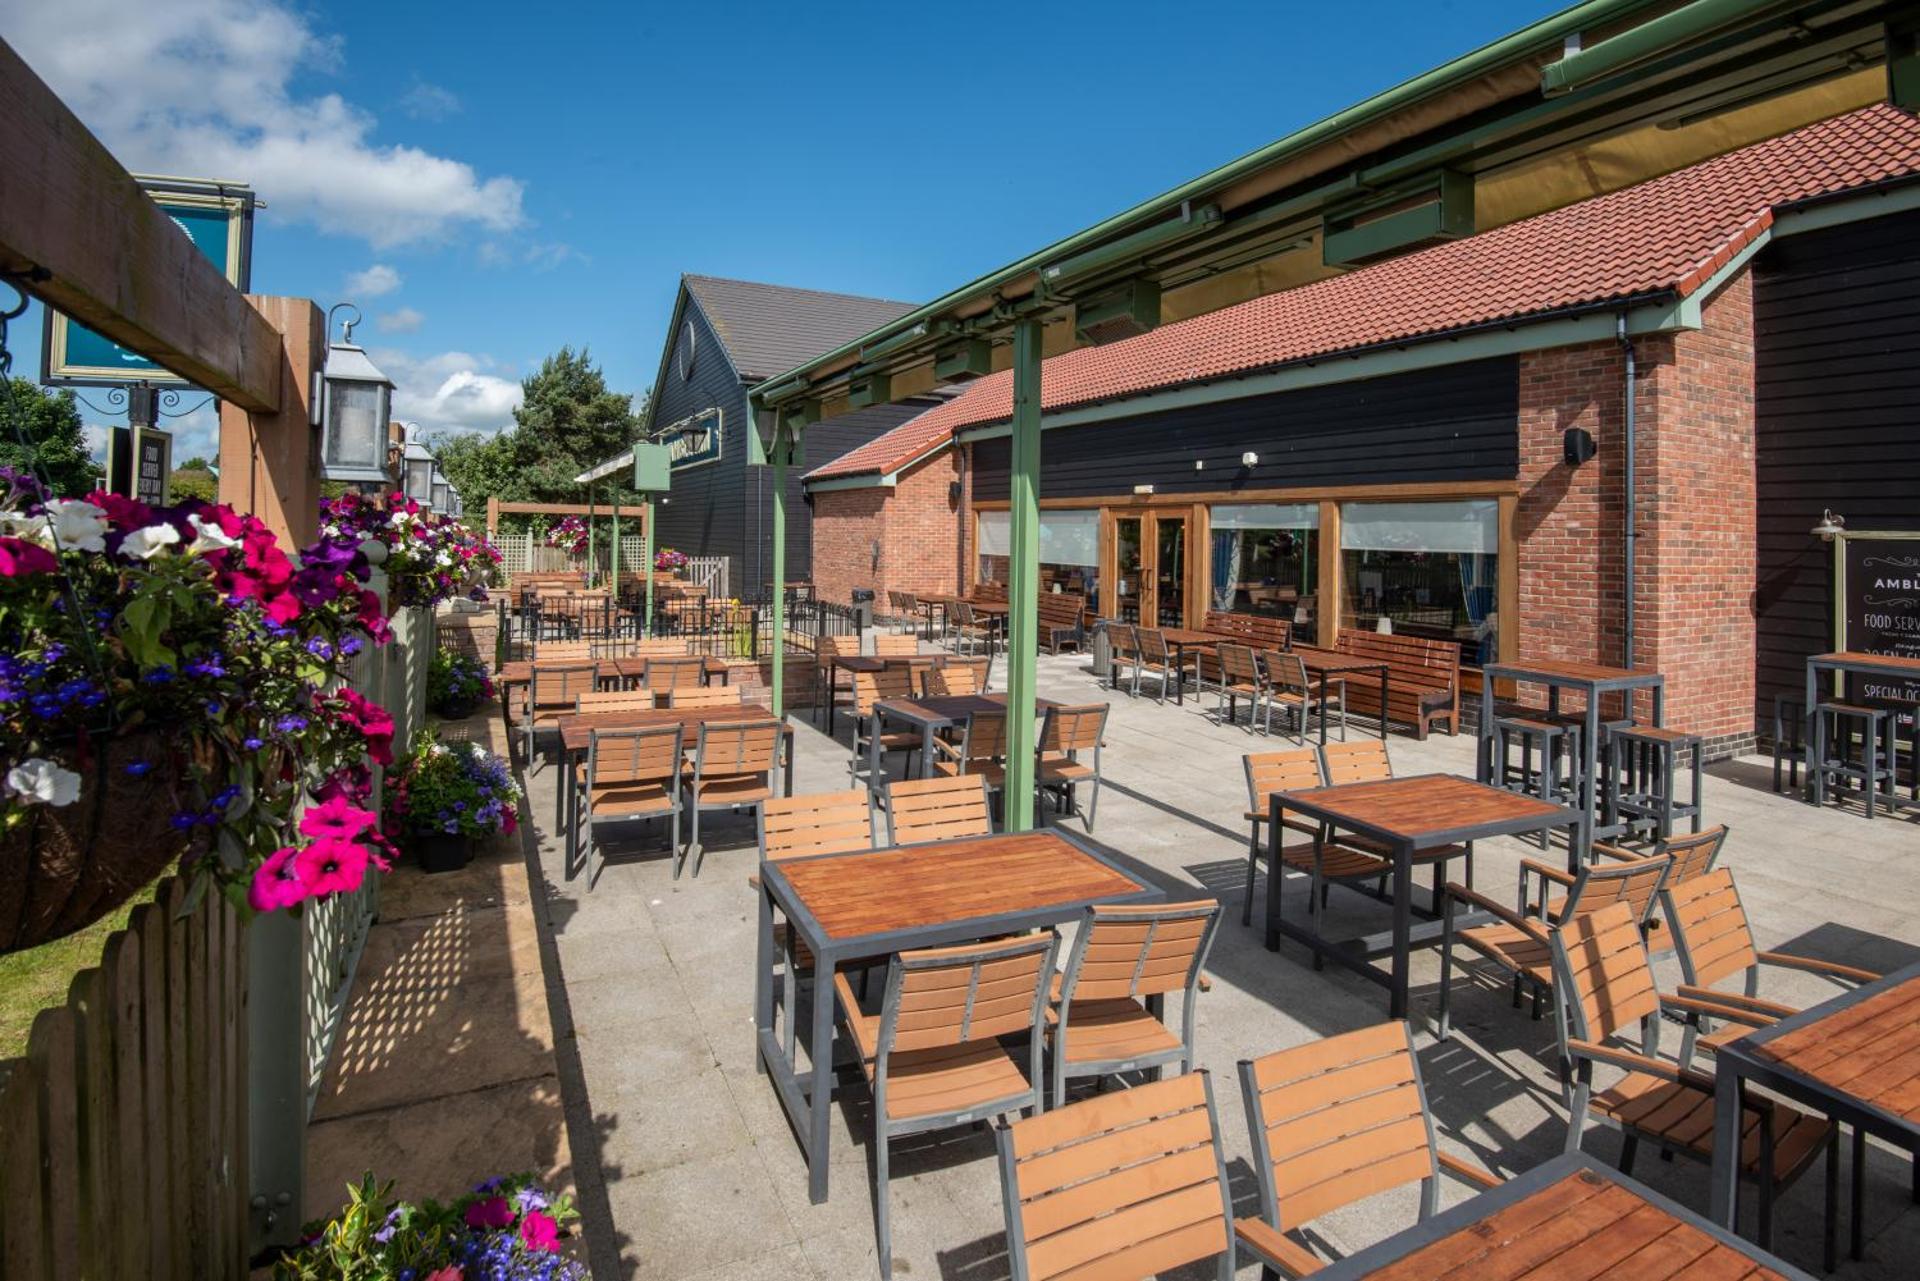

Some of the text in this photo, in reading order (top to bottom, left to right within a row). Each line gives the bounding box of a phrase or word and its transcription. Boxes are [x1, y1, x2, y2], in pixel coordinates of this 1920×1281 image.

[1874, 578, 1920, 590] AMBL
[1864, 613, 1920, 631] FOOD SERV
[1864, 683, 1903, 700] SPECIAL
